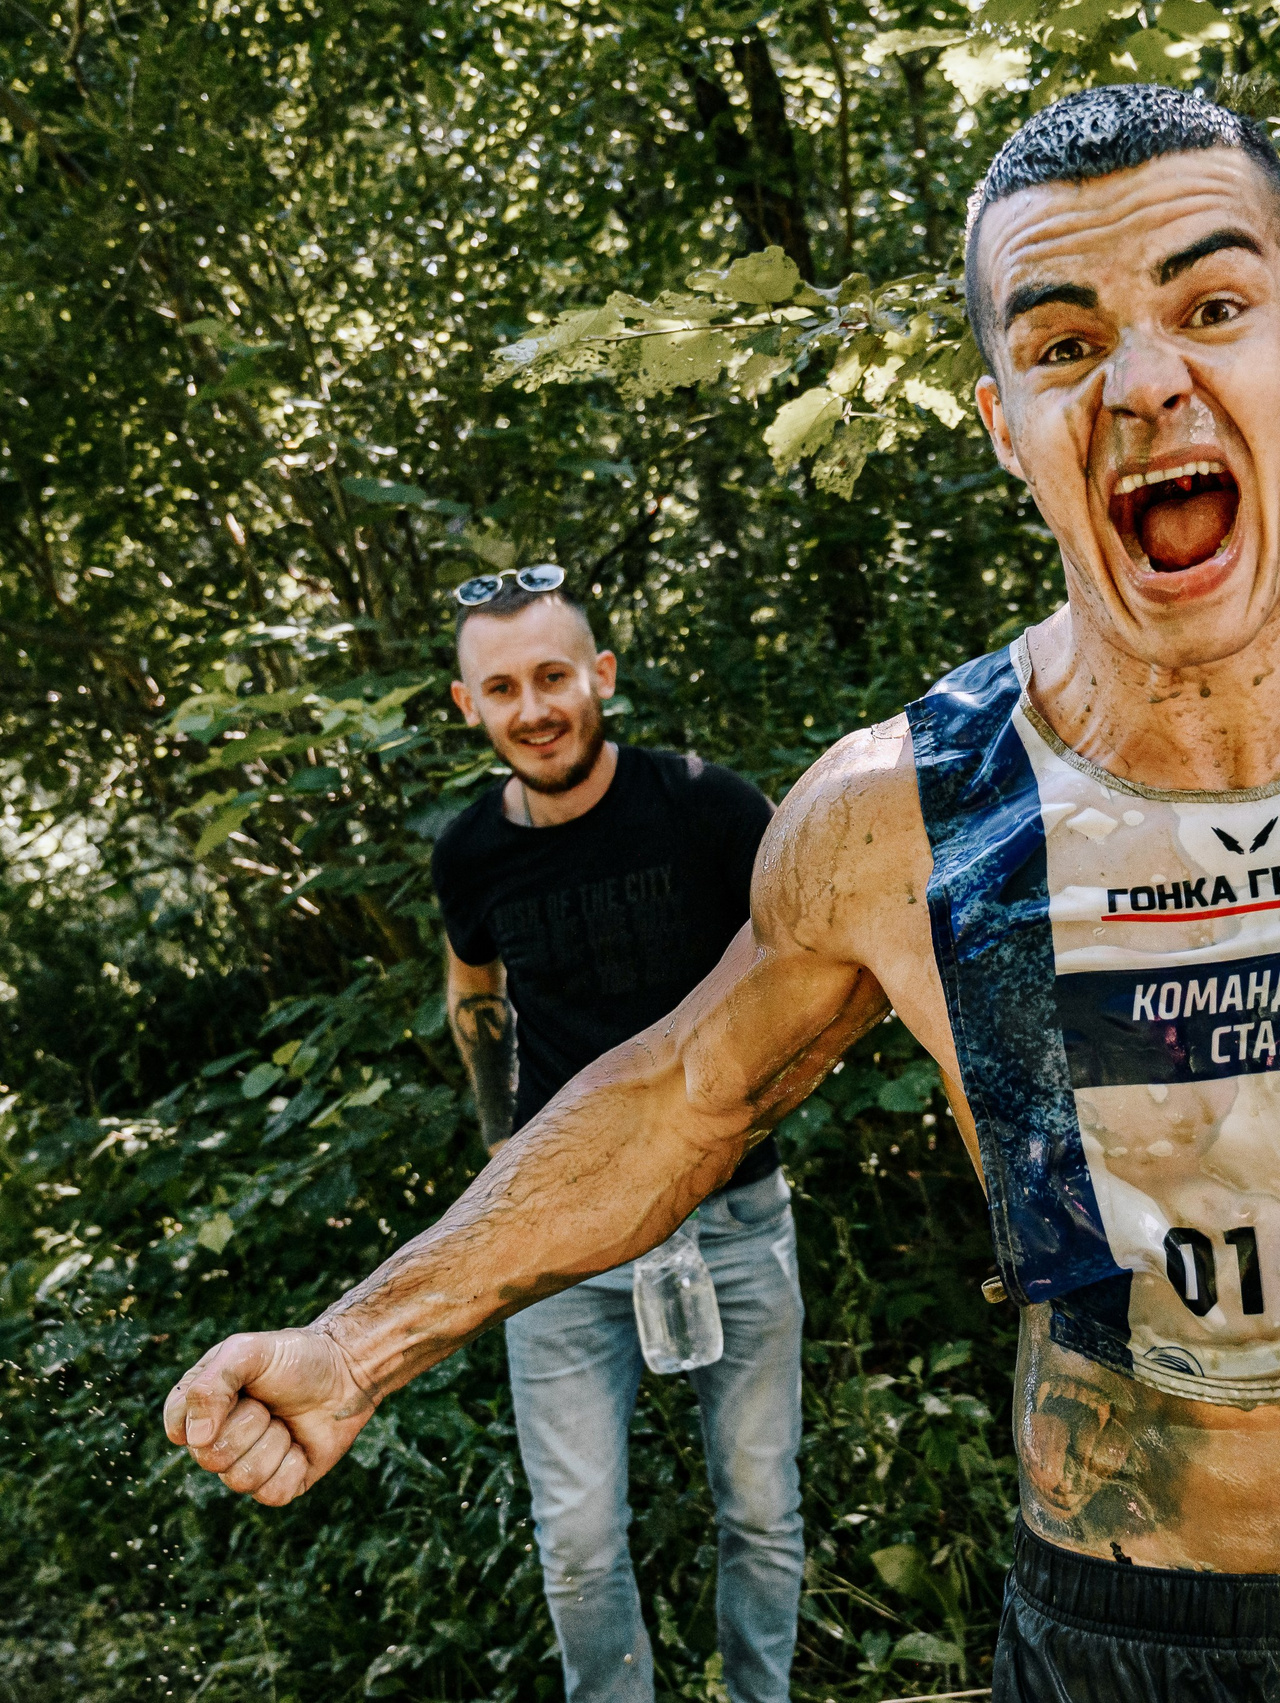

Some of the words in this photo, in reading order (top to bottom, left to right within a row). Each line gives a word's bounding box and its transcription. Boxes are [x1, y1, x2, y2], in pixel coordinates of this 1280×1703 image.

[546, 888, 571, 919] OF
[578, 878, 622, 914] THE
[624, 863, 672, 903] CITY
[1107, 874, 1238, 914] ГОНКА
